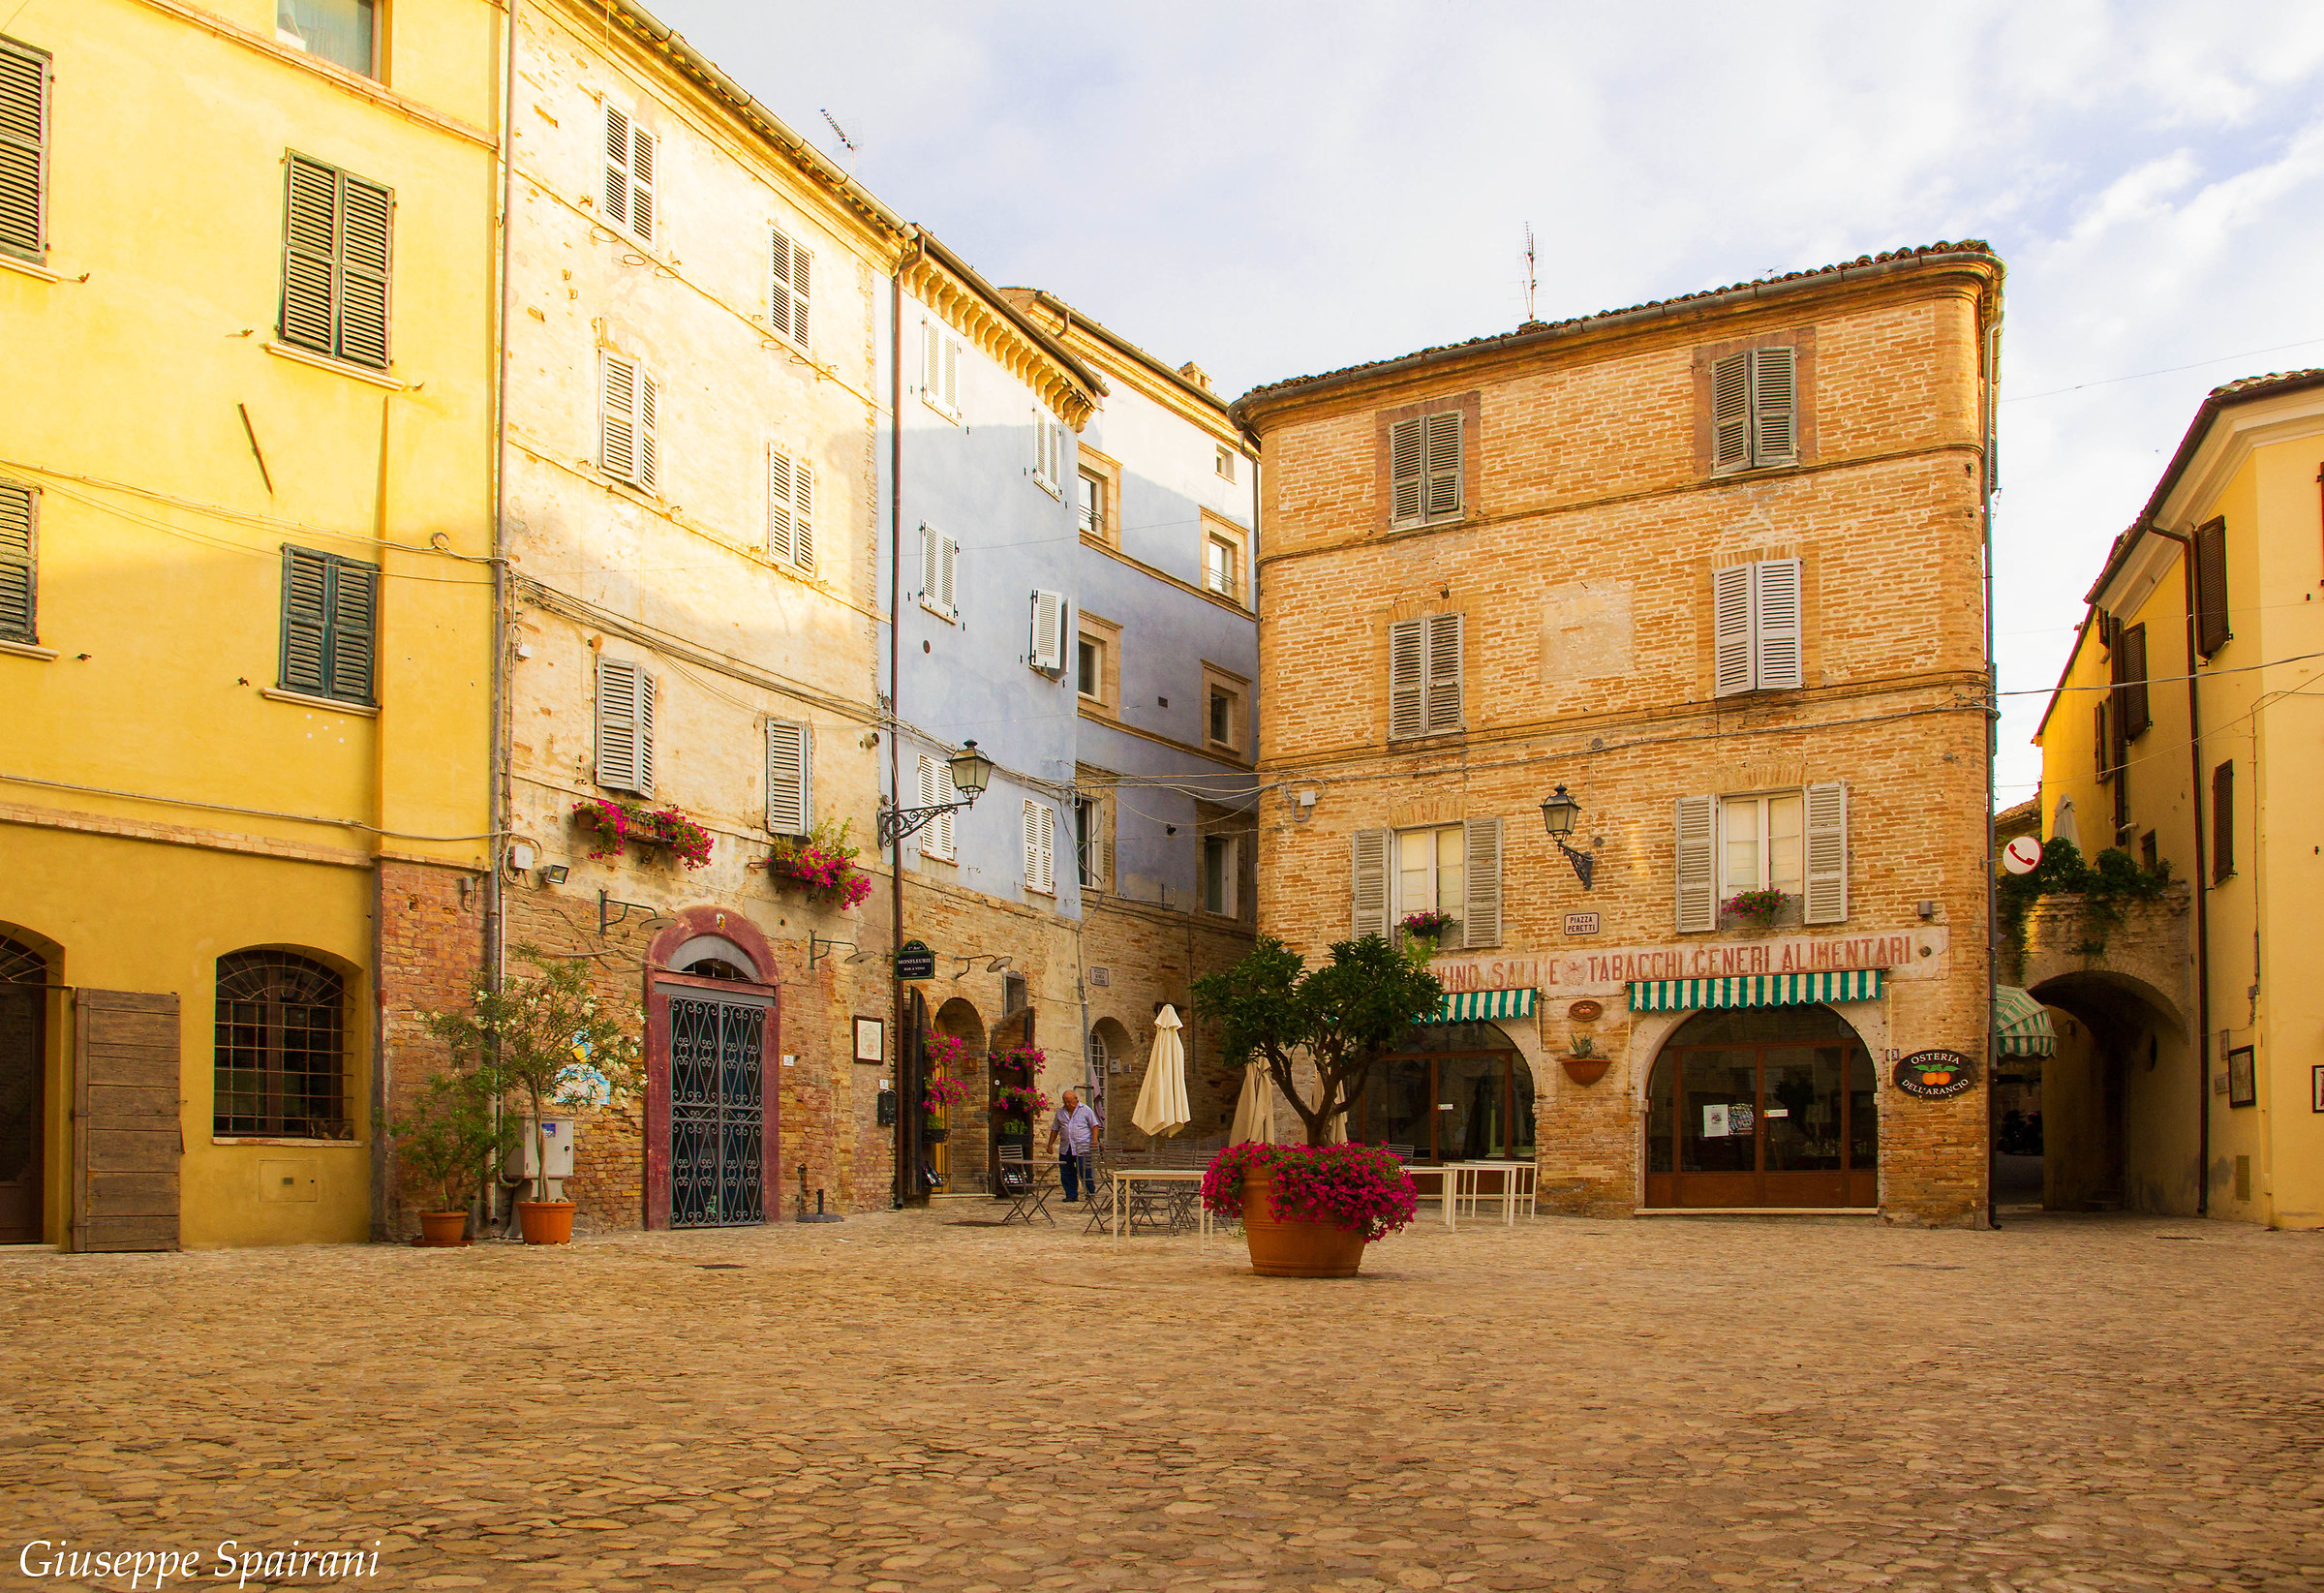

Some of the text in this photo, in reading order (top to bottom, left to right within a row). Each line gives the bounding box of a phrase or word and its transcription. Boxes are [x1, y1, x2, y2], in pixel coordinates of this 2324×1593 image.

[1587, 951, 1682, 983] TABACCHI
[1782, 936, 1911, 971] ALIMENTARI
[1911, 1053, 1960, 1064] OSTERIA
[1902, 1079, 1969, 1094] DELL'ARANCIO
